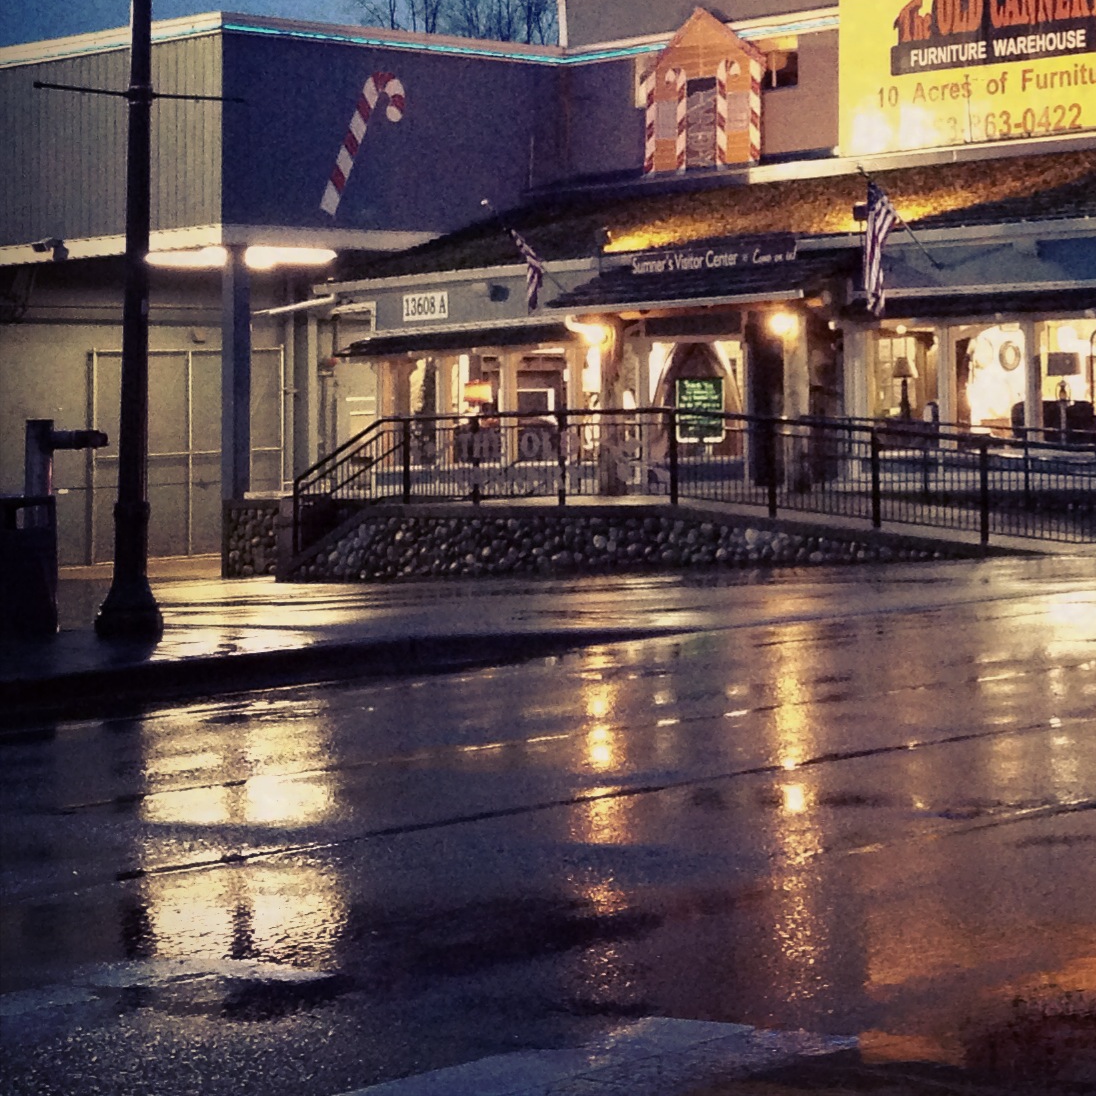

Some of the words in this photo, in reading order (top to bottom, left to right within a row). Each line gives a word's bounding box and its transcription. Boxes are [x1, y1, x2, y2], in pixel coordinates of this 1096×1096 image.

[910, 40, 987, 68] FURNITURE
[993, 29, 1087, 57] WAREHOUSE
[877, 85, 899, 108] 10
[911, 80, 972, 104] Acres
[986, 72, 1008, 96] of
[674, 252, 704, 270] Visitor
[705, 249, 738, 268] Center
[405, 296, 436, 317] 13608
[439, 295, 446, 314] A
